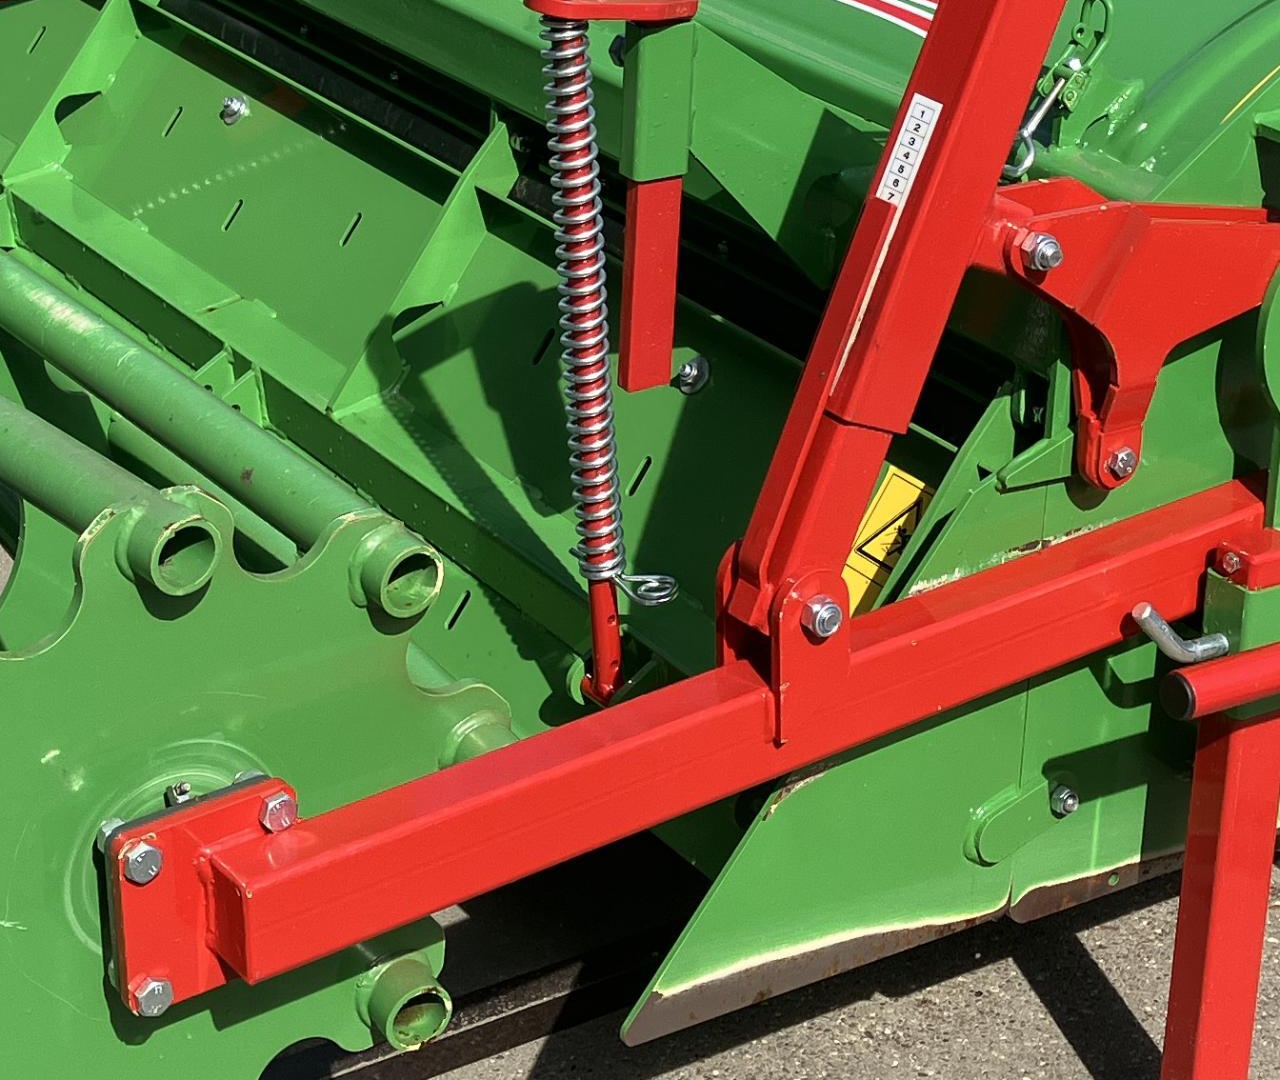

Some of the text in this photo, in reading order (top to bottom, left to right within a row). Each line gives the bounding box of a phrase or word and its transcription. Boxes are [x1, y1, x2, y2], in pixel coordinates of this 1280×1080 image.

[920, 110, 926, 119] 1
[913, 123, 921, 133] 2
[908, 137, 916, 146] 3
[902, 151, 910, 160] 4
[897, 164, 905, 174] 5
[892, 178, 900, 188] 6
[887, 192, 895, 201] 7
